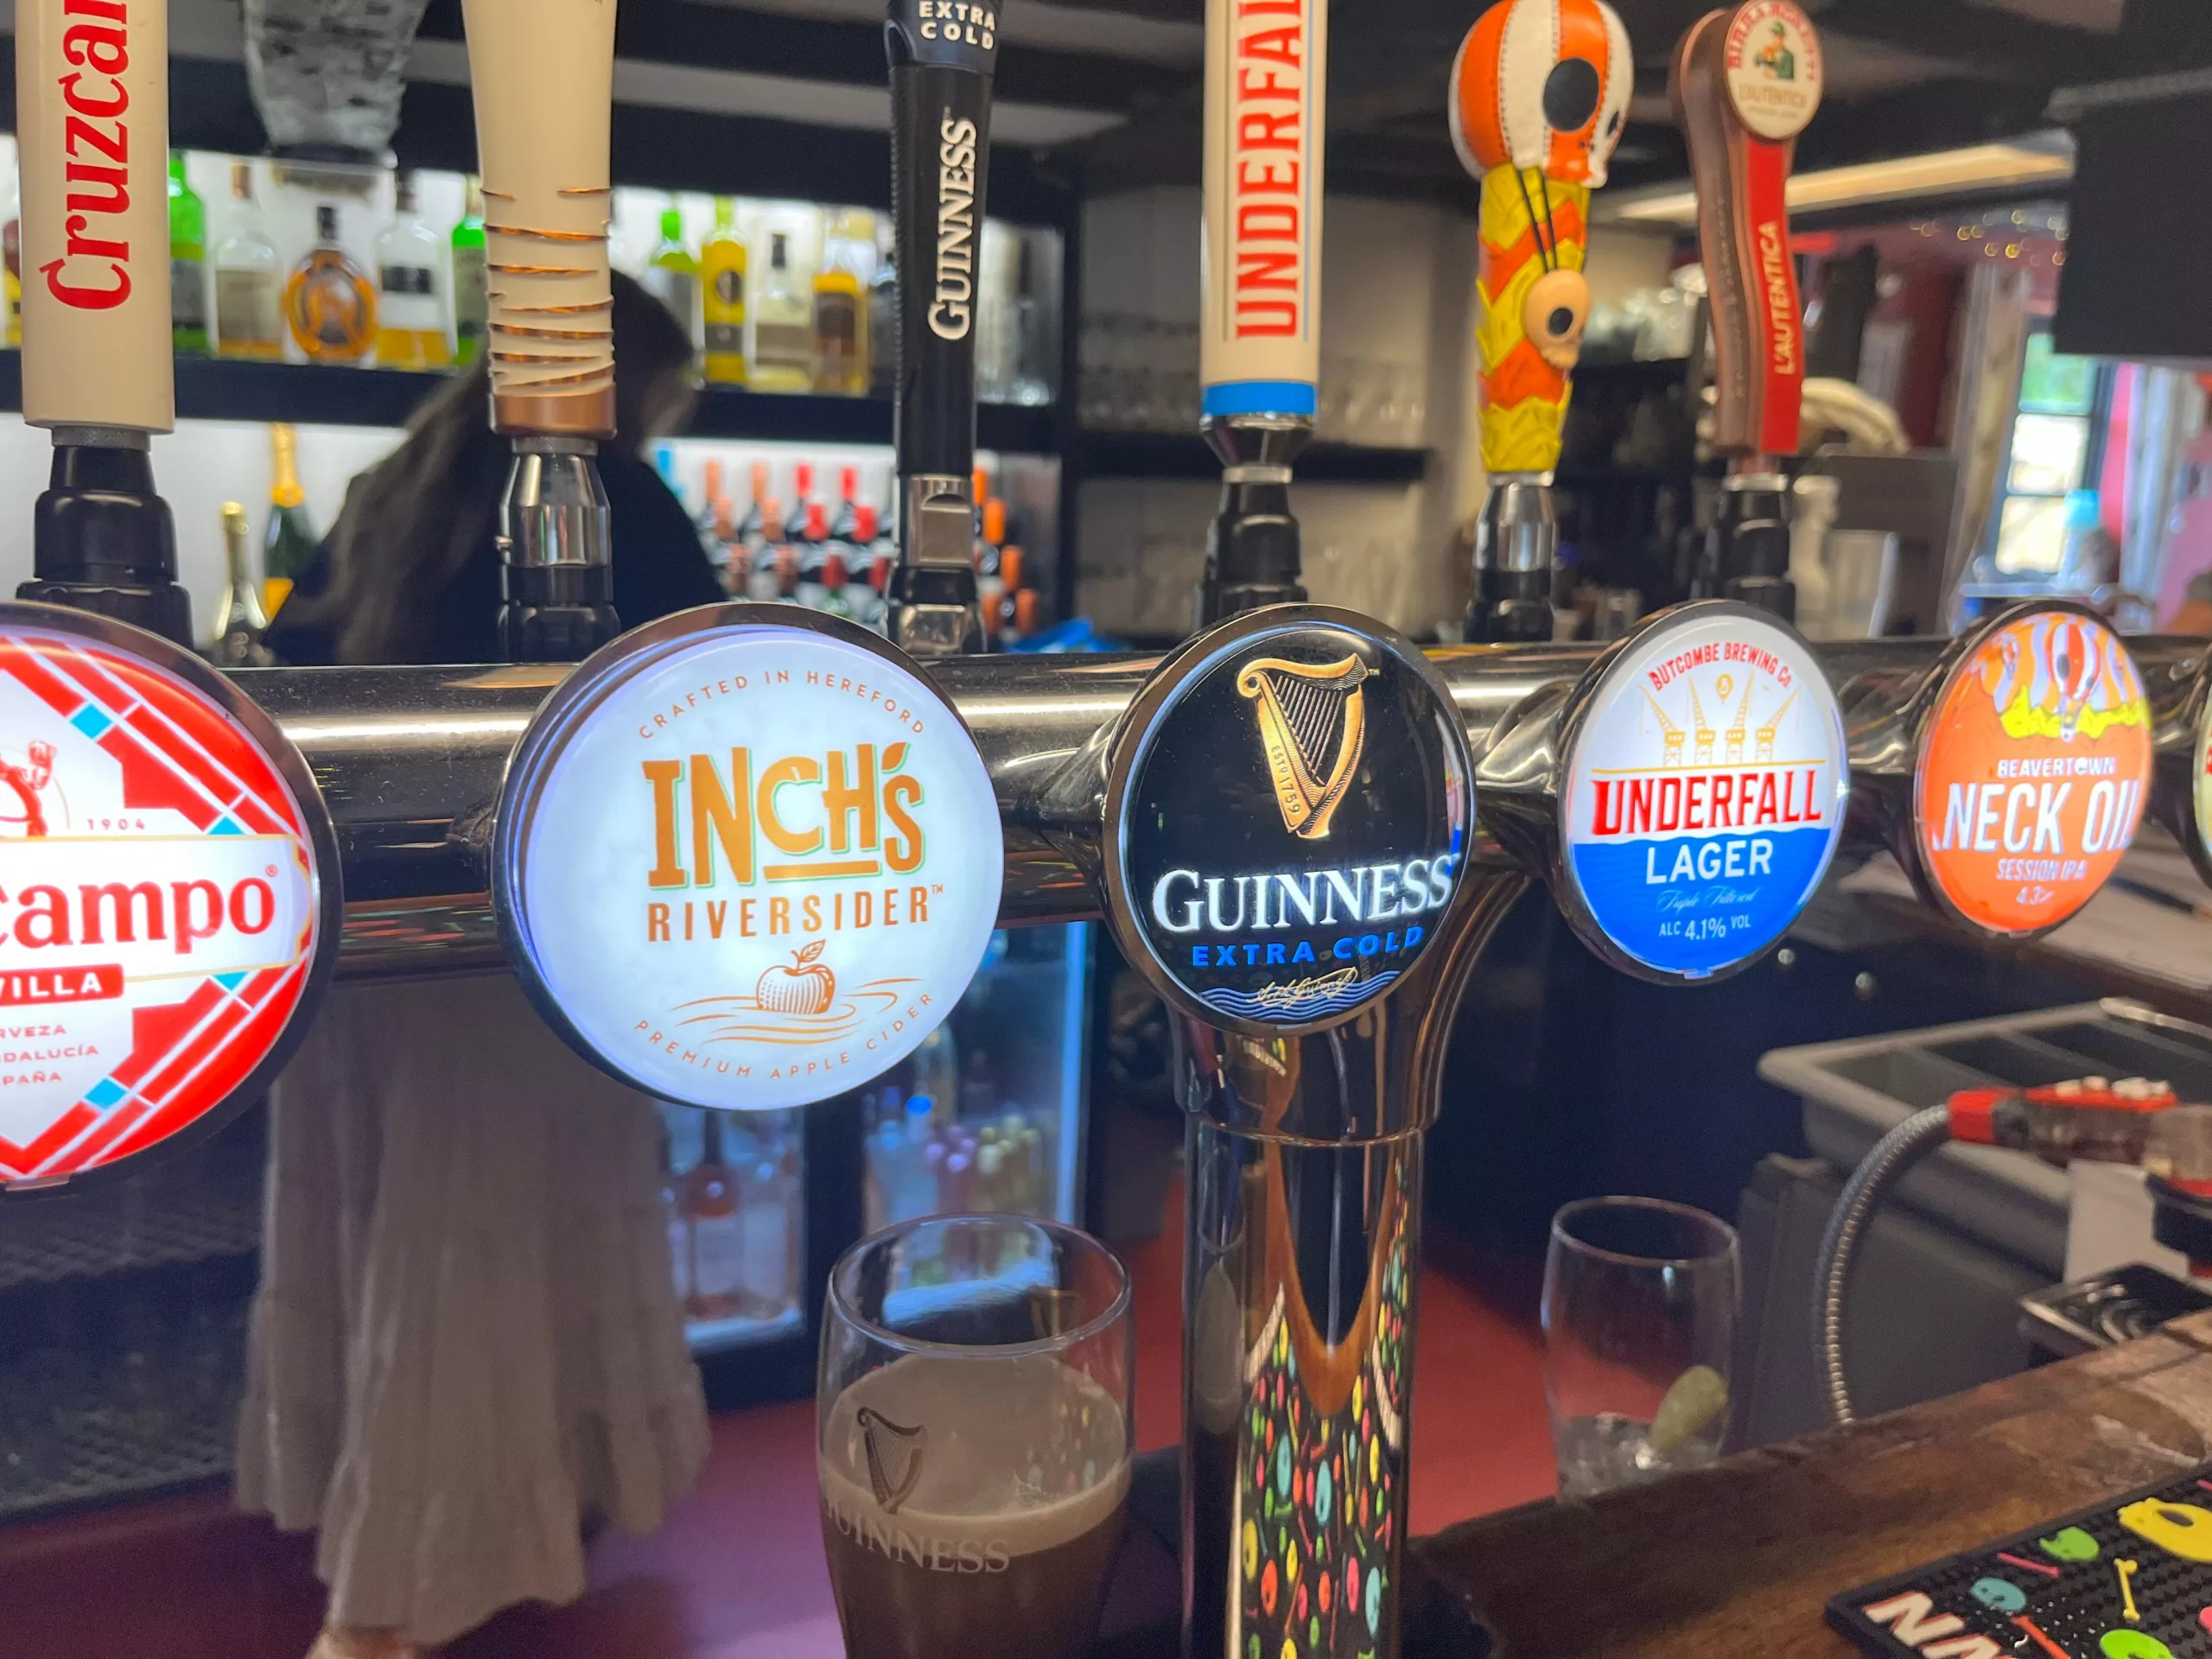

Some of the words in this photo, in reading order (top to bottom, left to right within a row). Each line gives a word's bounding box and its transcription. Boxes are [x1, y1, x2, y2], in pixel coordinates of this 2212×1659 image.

[918, 0, 995, 31] EXTRA
[920, 21, 994, 50] COLD
[927, 109, 977, 340] GUINNESS
[1648, 643, 1719, 692] BUTCOMBE
[1724, 642, 1778, 675] BREWING
[639, 675, 747, 738] CRAFTED
[765, 670, 789, 684] IN
[807, 671, 924, 733] HEREFORD
[1997, 757, 2115, 778] BEAVERTOWN
[1279, 777, 1300, 813] 1759
[1591, 769, 1821, 835] UNDERFALL
[87, 818, 145, 830] 1904
[1936, 782, 2072, 855] NECK
[1646, 838, 1773, 885] LAGER
[1996, 858, 2060, 880] SESSION
[2061, 860, 2088, 880] IPA
[1153, 854, 1459, 933] GUINNESS
[1192, 941, 1316, 967] EXTRA
[1333, 926, 1424, 961] COLD
[1659, 921, 1681, 937] ALC
[1685, 917, 1726, 940] 4.1%
[1731, 914, 1751, 929] VOL
[0, 1044, 99, 1064] DALUCÍA
[635, 1020, 750, 1077] PREMIUM
[771, 1052, 849, 1078] APPLE
[867, 994, 932, 1050] CIDER
